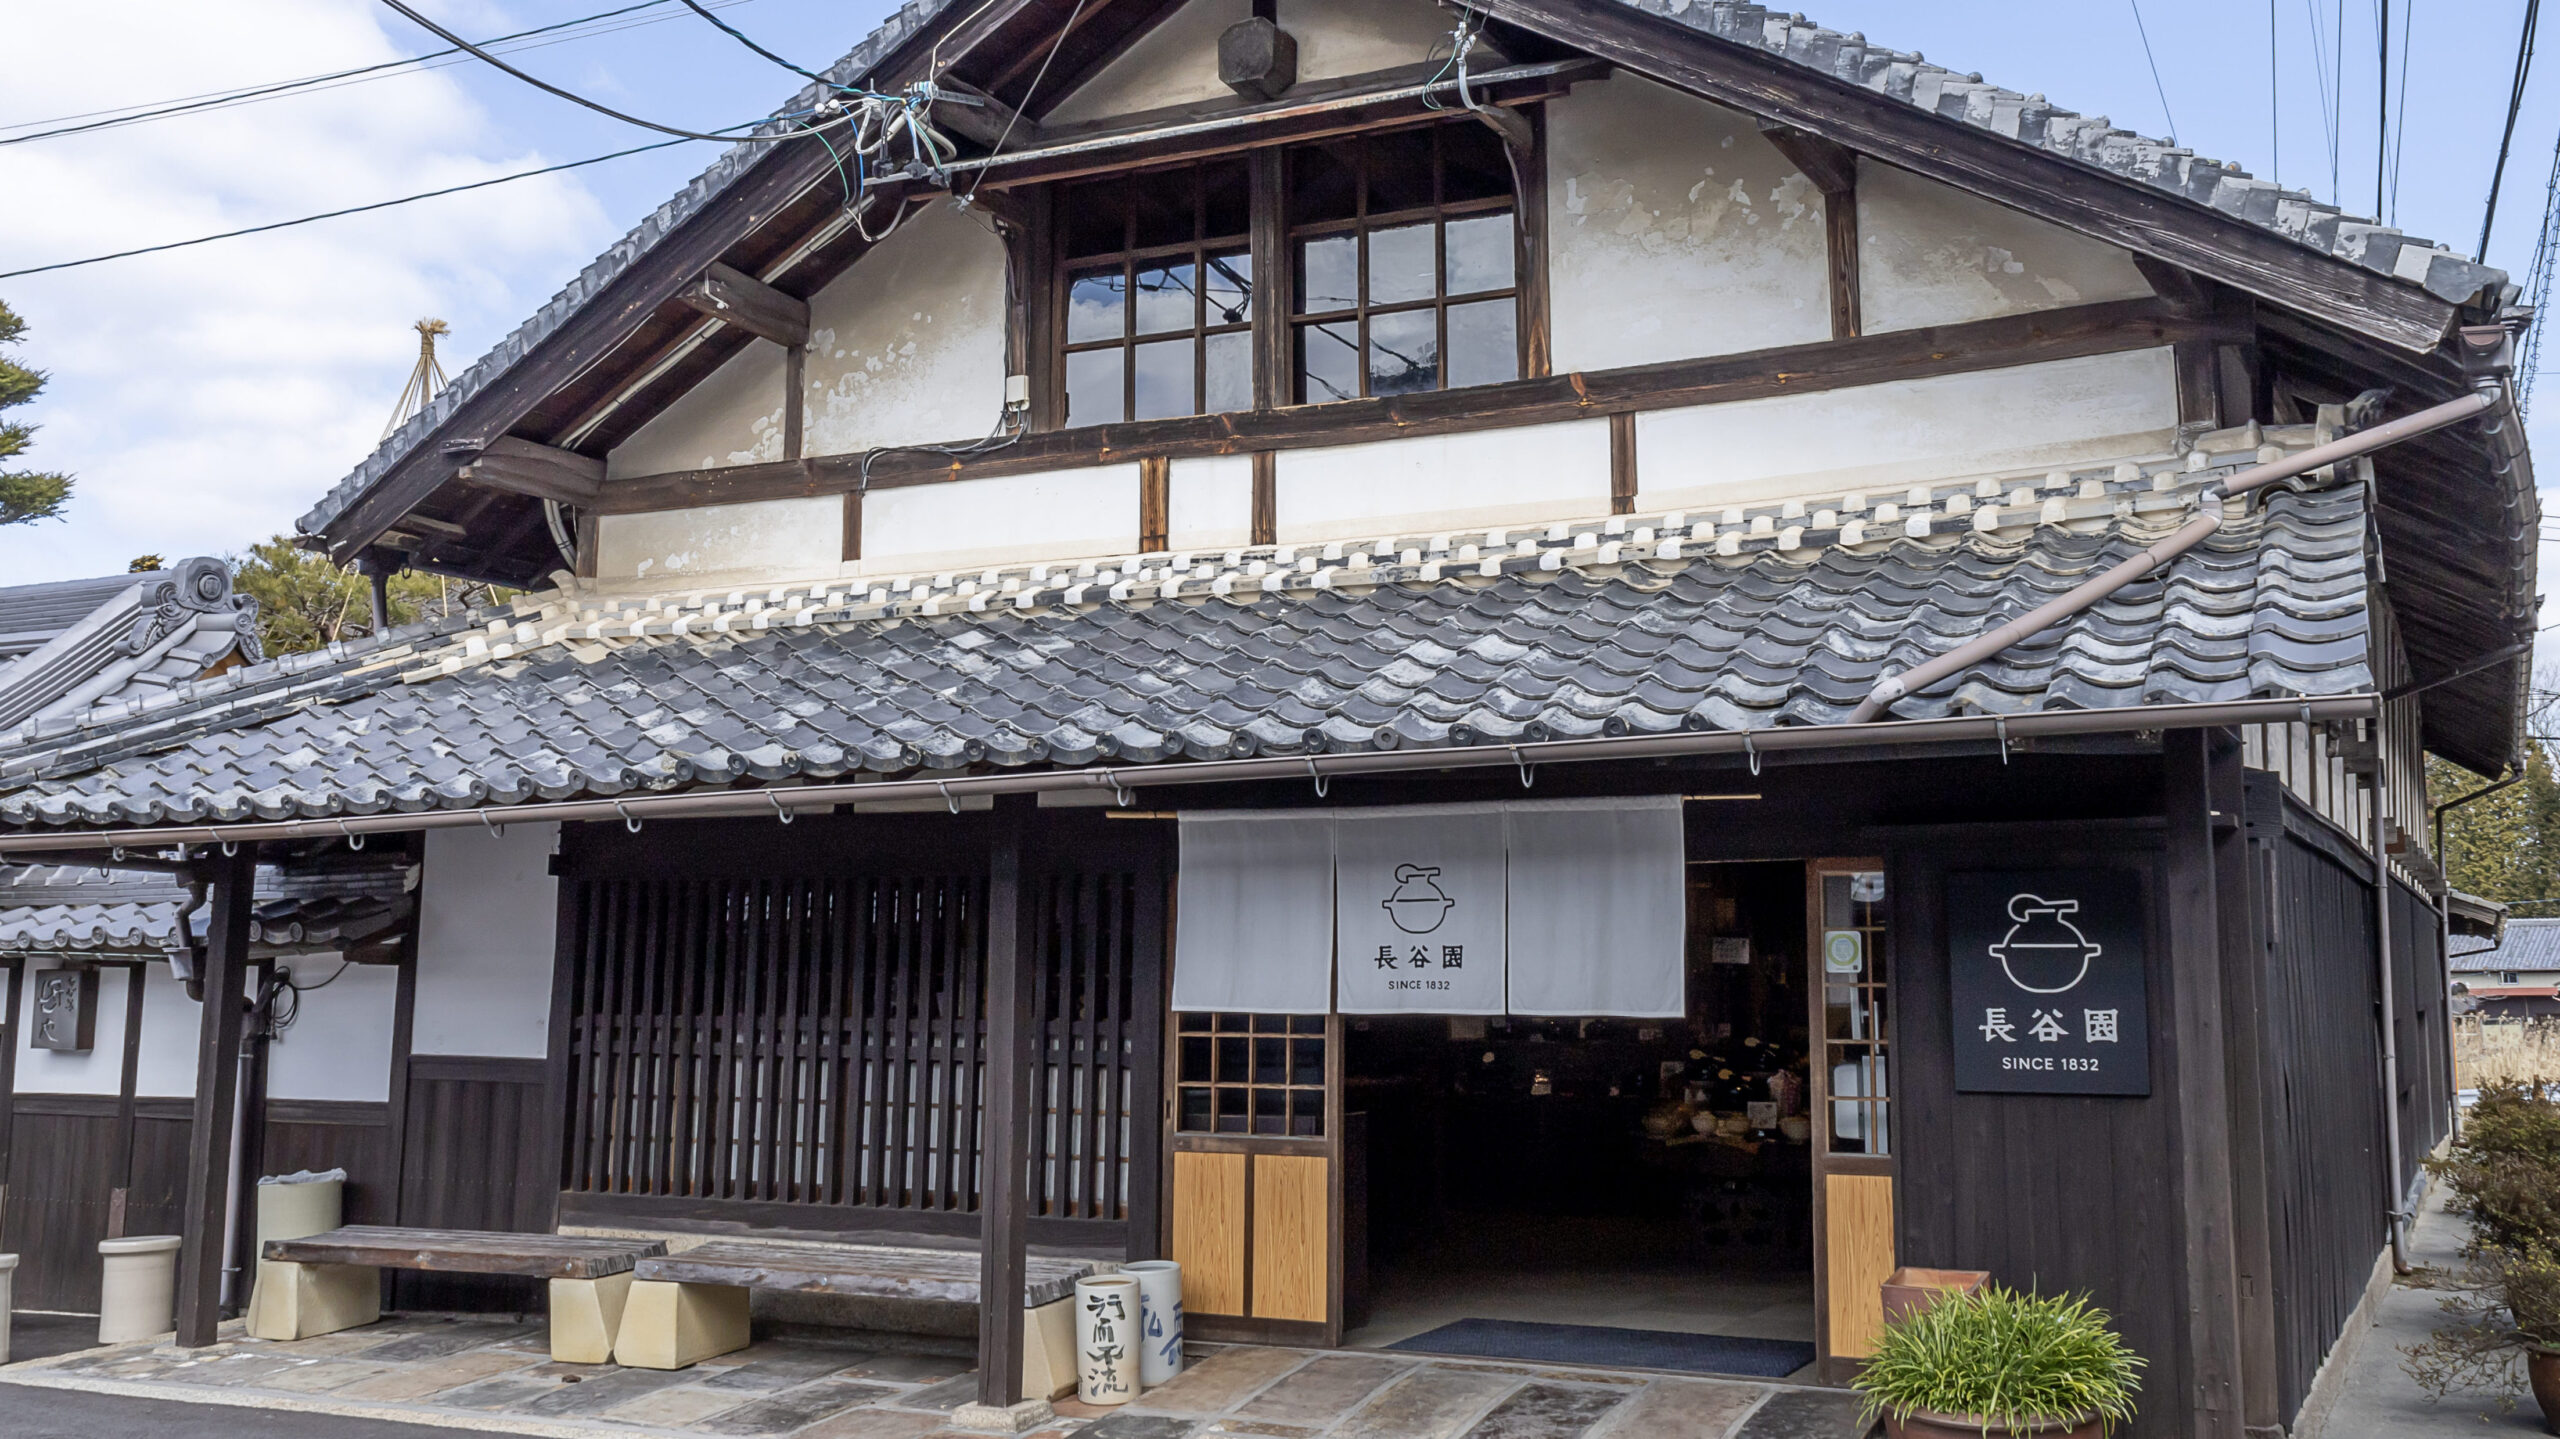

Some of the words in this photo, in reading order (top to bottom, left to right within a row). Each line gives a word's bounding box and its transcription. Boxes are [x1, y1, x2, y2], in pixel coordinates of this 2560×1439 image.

[1373, 944, 1464, 970] 長谷園
[1388, 980, 1422, 991] SINCE
[1425, 979, 1450, 991] 1832
[1978, 1007, 2119, 1044] 長谷園
[2002, 1056, 2055, 1071] SINCE
[2060, 1057, 2100, 1072] 1832
